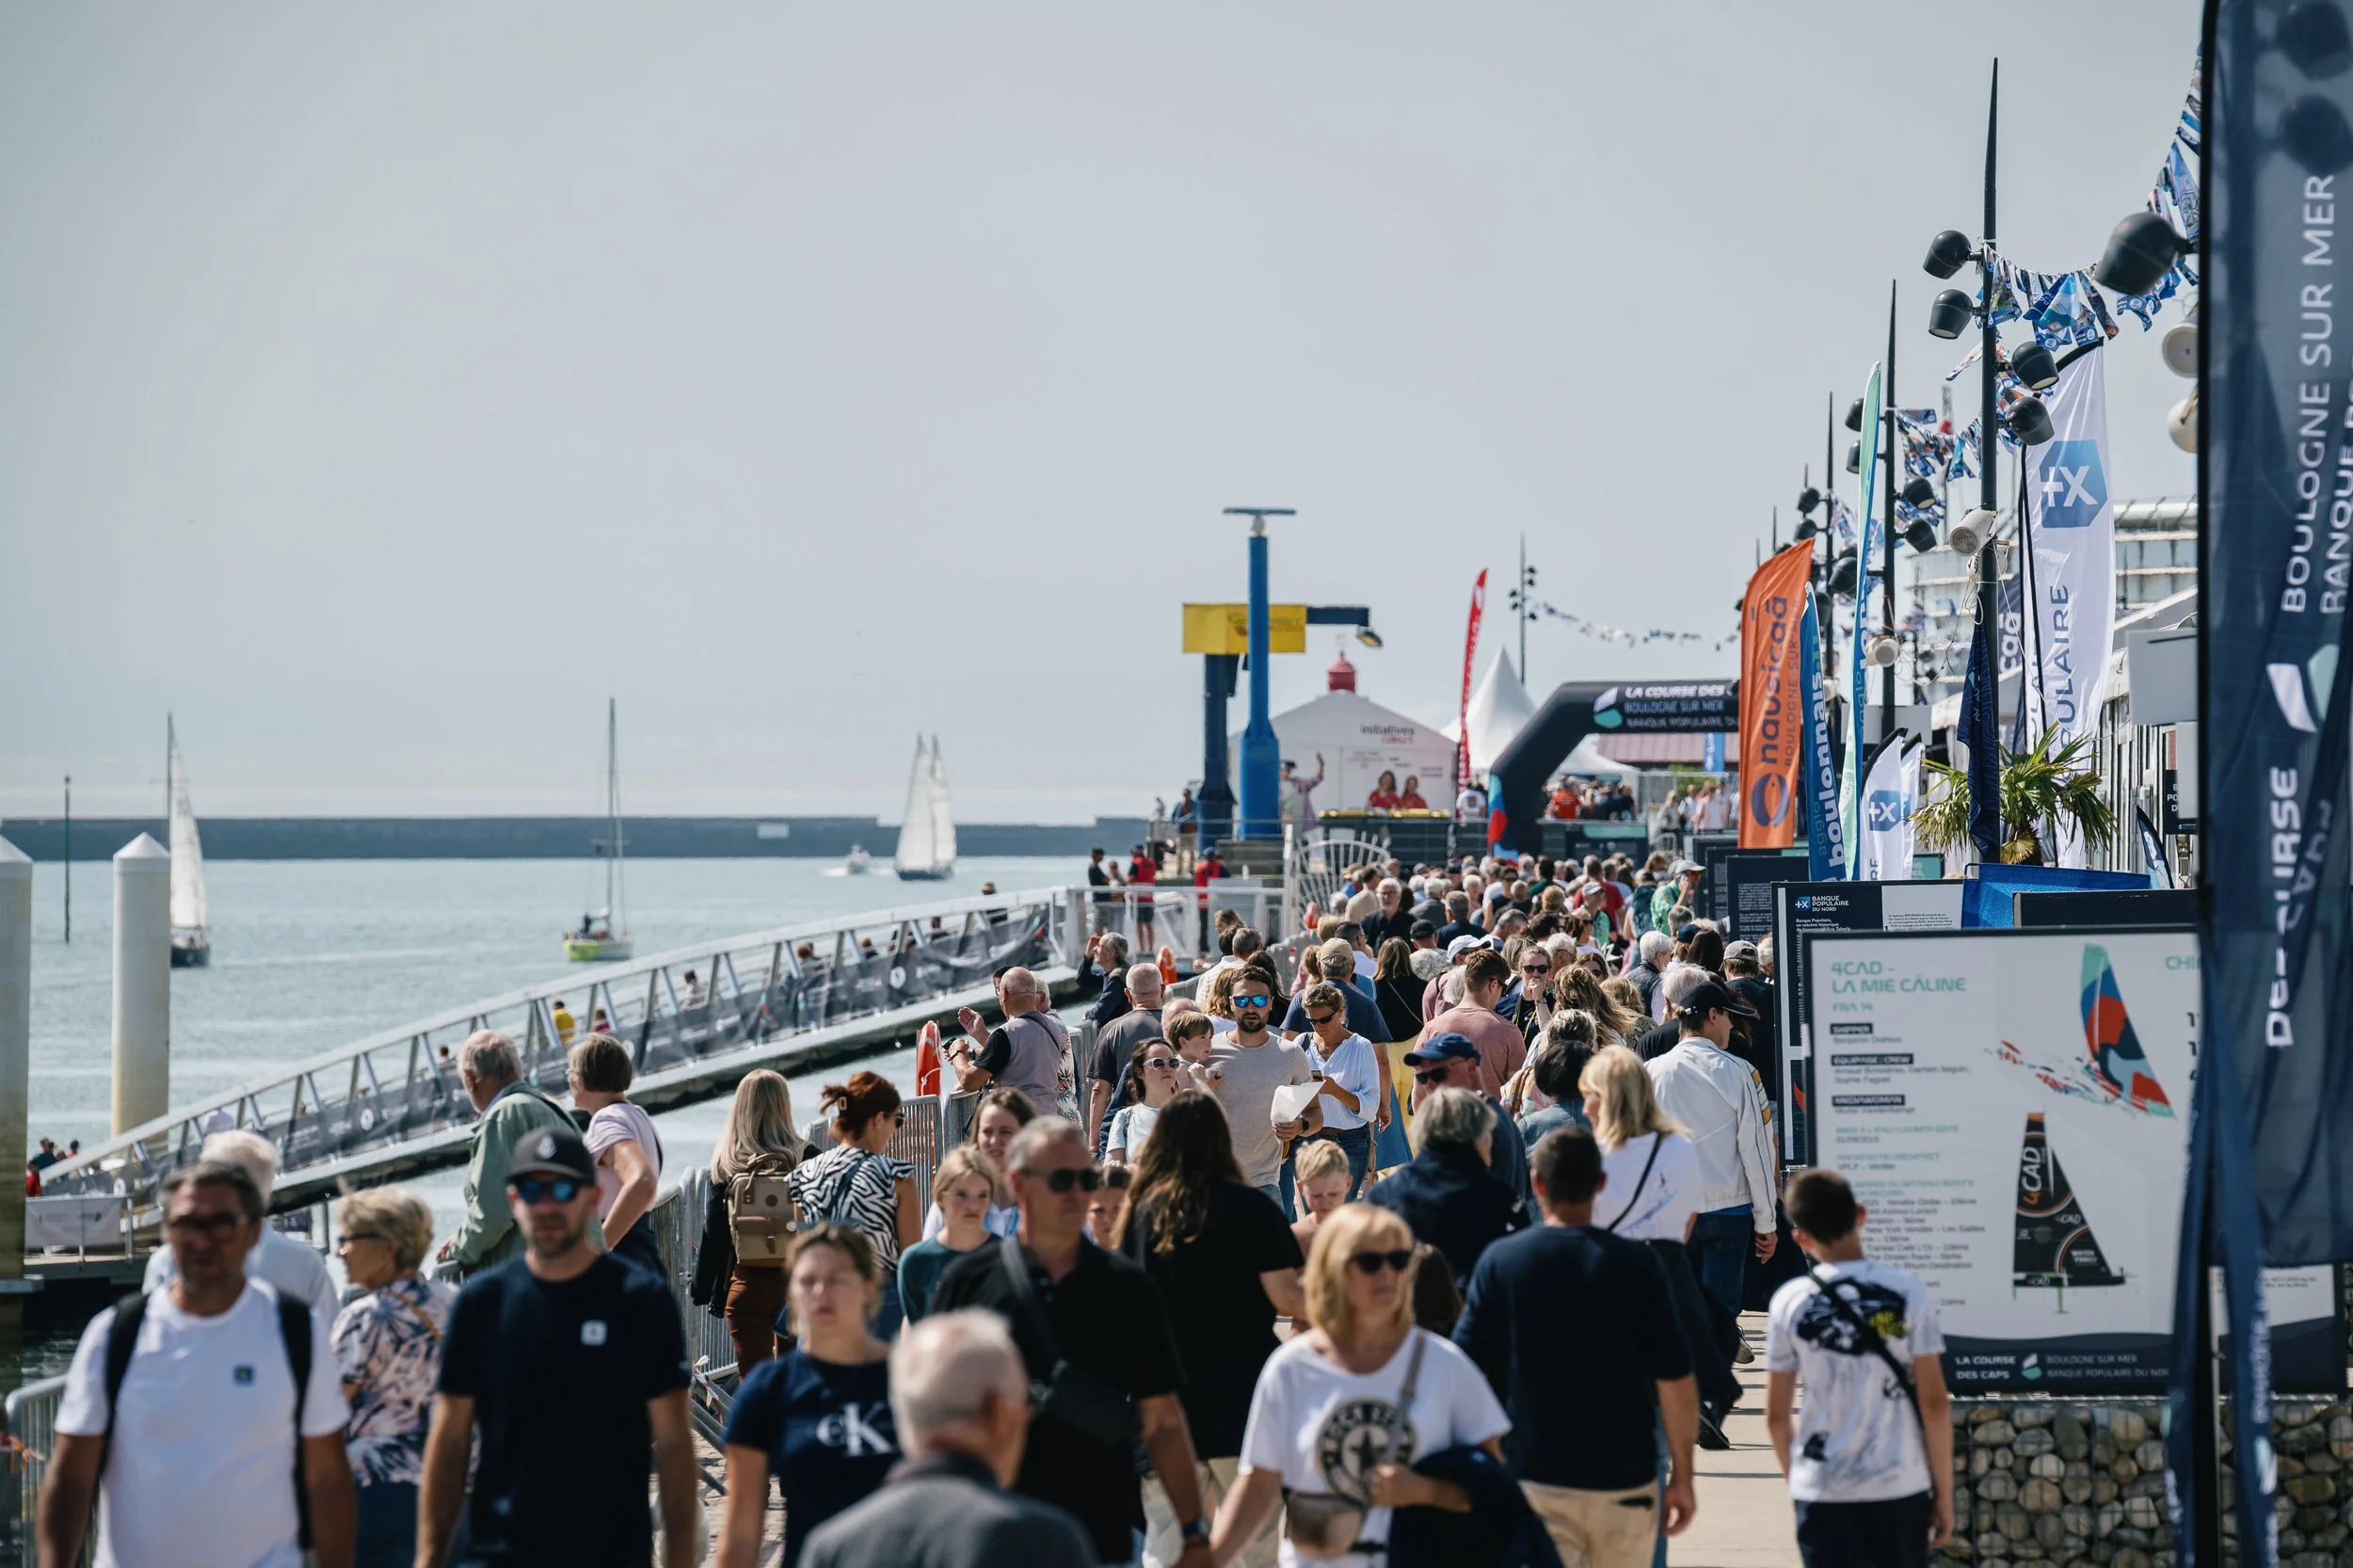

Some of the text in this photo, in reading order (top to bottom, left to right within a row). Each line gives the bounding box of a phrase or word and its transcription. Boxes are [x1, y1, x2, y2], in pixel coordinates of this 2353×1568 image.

[2281, 175, 2334, 613] BOULOGNE SUR MER
[1625, 684, 1725, 698] LA COURSE DES
[1625, 699, 1725, 713] BOULOGNE SUR MER
[1812, 801, 1827, 857] agglo
[1831, 961, 1882, 975] 4CAD
[1833, 974, 1967, 994] LA MIE CÂLINE
[1955, 1355, 2016, 1365] LA COURSE
[2046, 1354, 2137, 1364] BOULOGNE SUR MER
[1956, 1370, 2010, 1380] DES CAPS
[2047, 1368, 2169, 1378] BANQUE POPULAIRE DU NOR
